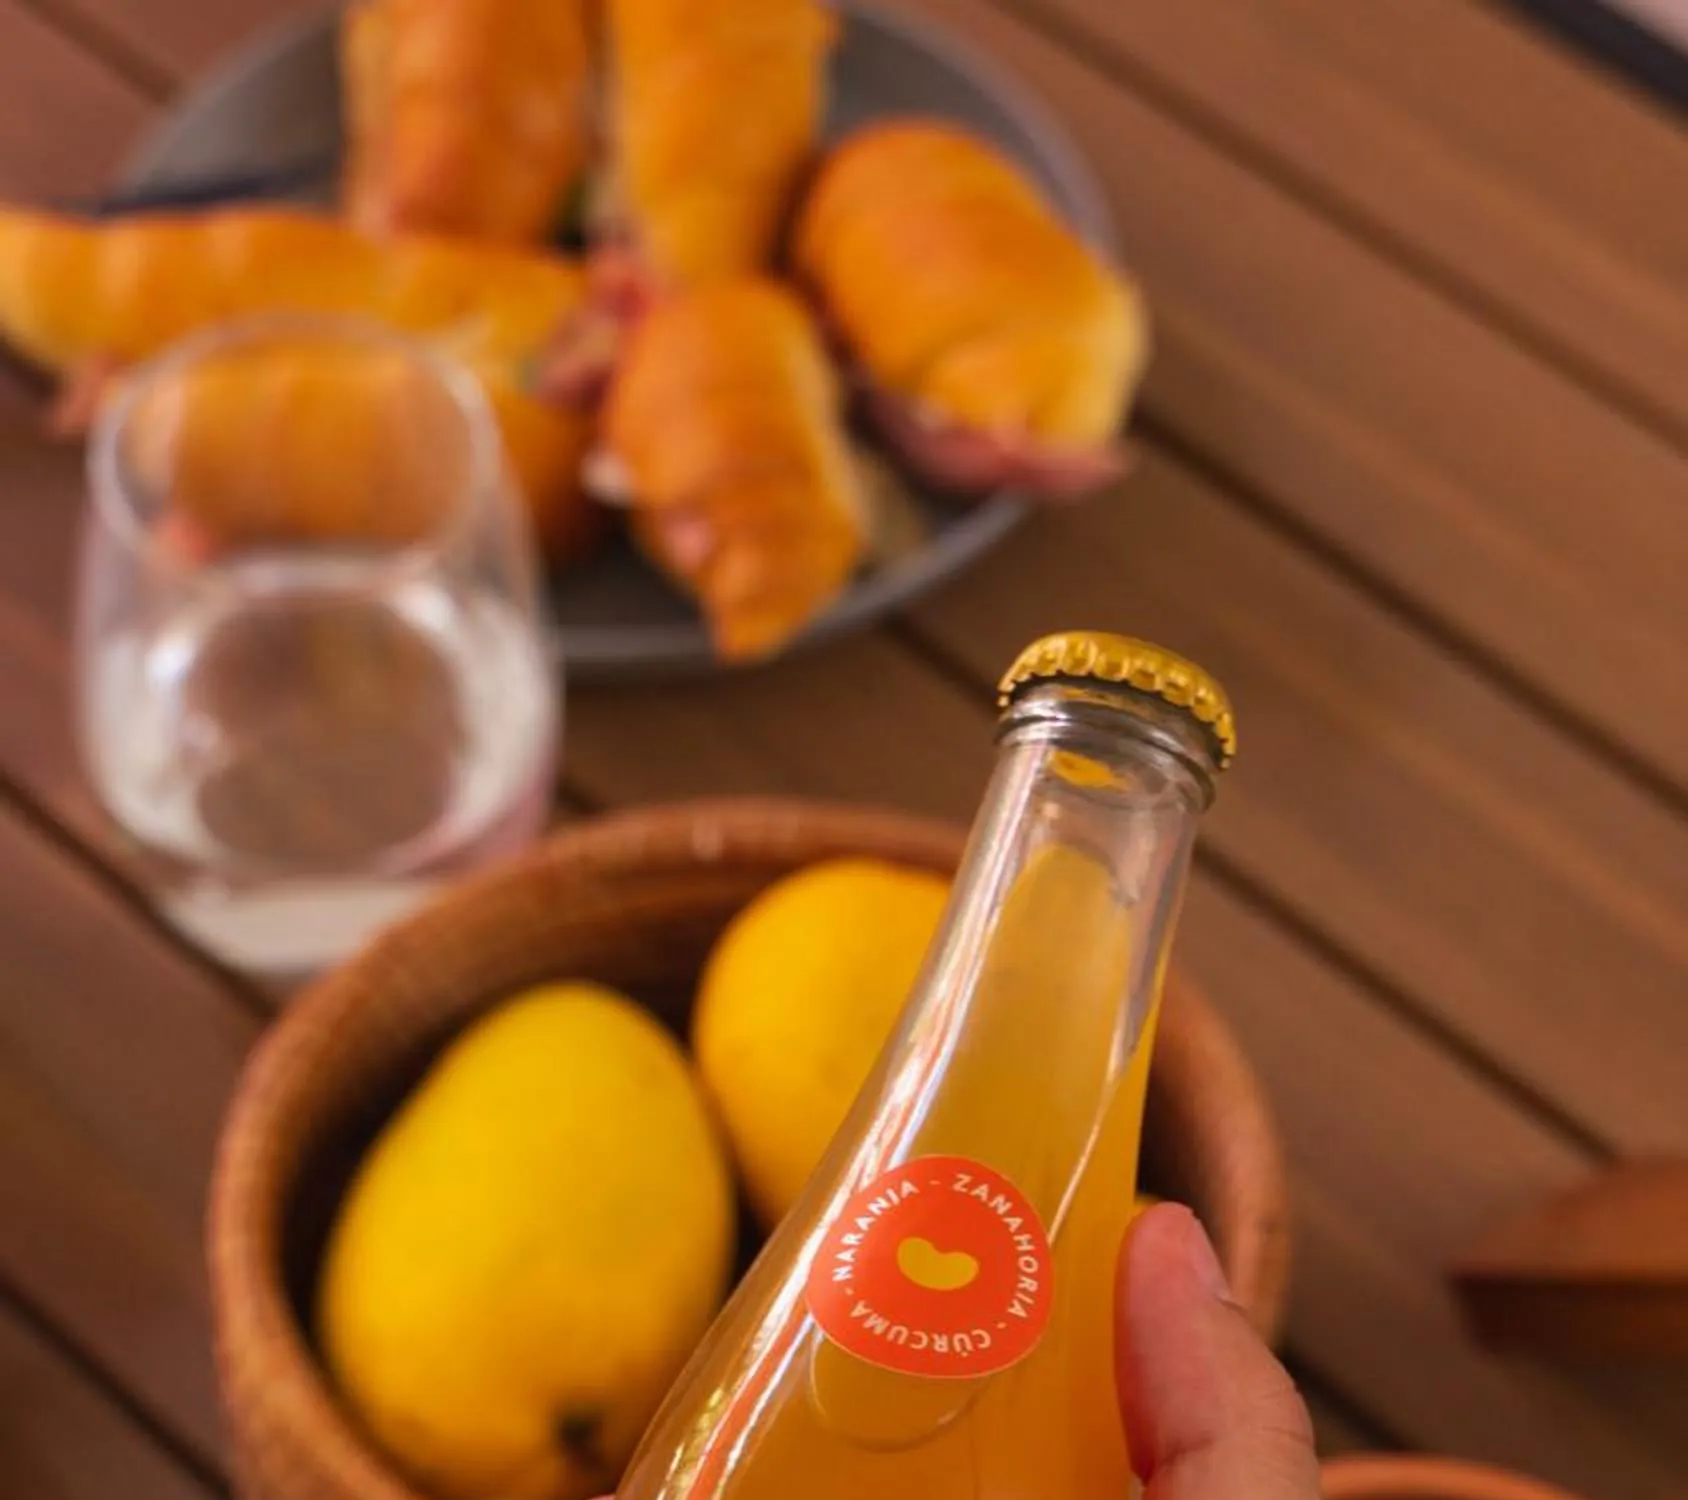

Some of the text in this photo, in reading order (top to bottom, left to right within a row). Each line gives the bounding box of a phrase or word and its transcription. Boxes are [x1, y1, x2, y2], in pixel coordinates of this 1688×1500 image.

[831, 1173, 1040, 1357] NARANJA ZANAHORIA CÚRCUMA
